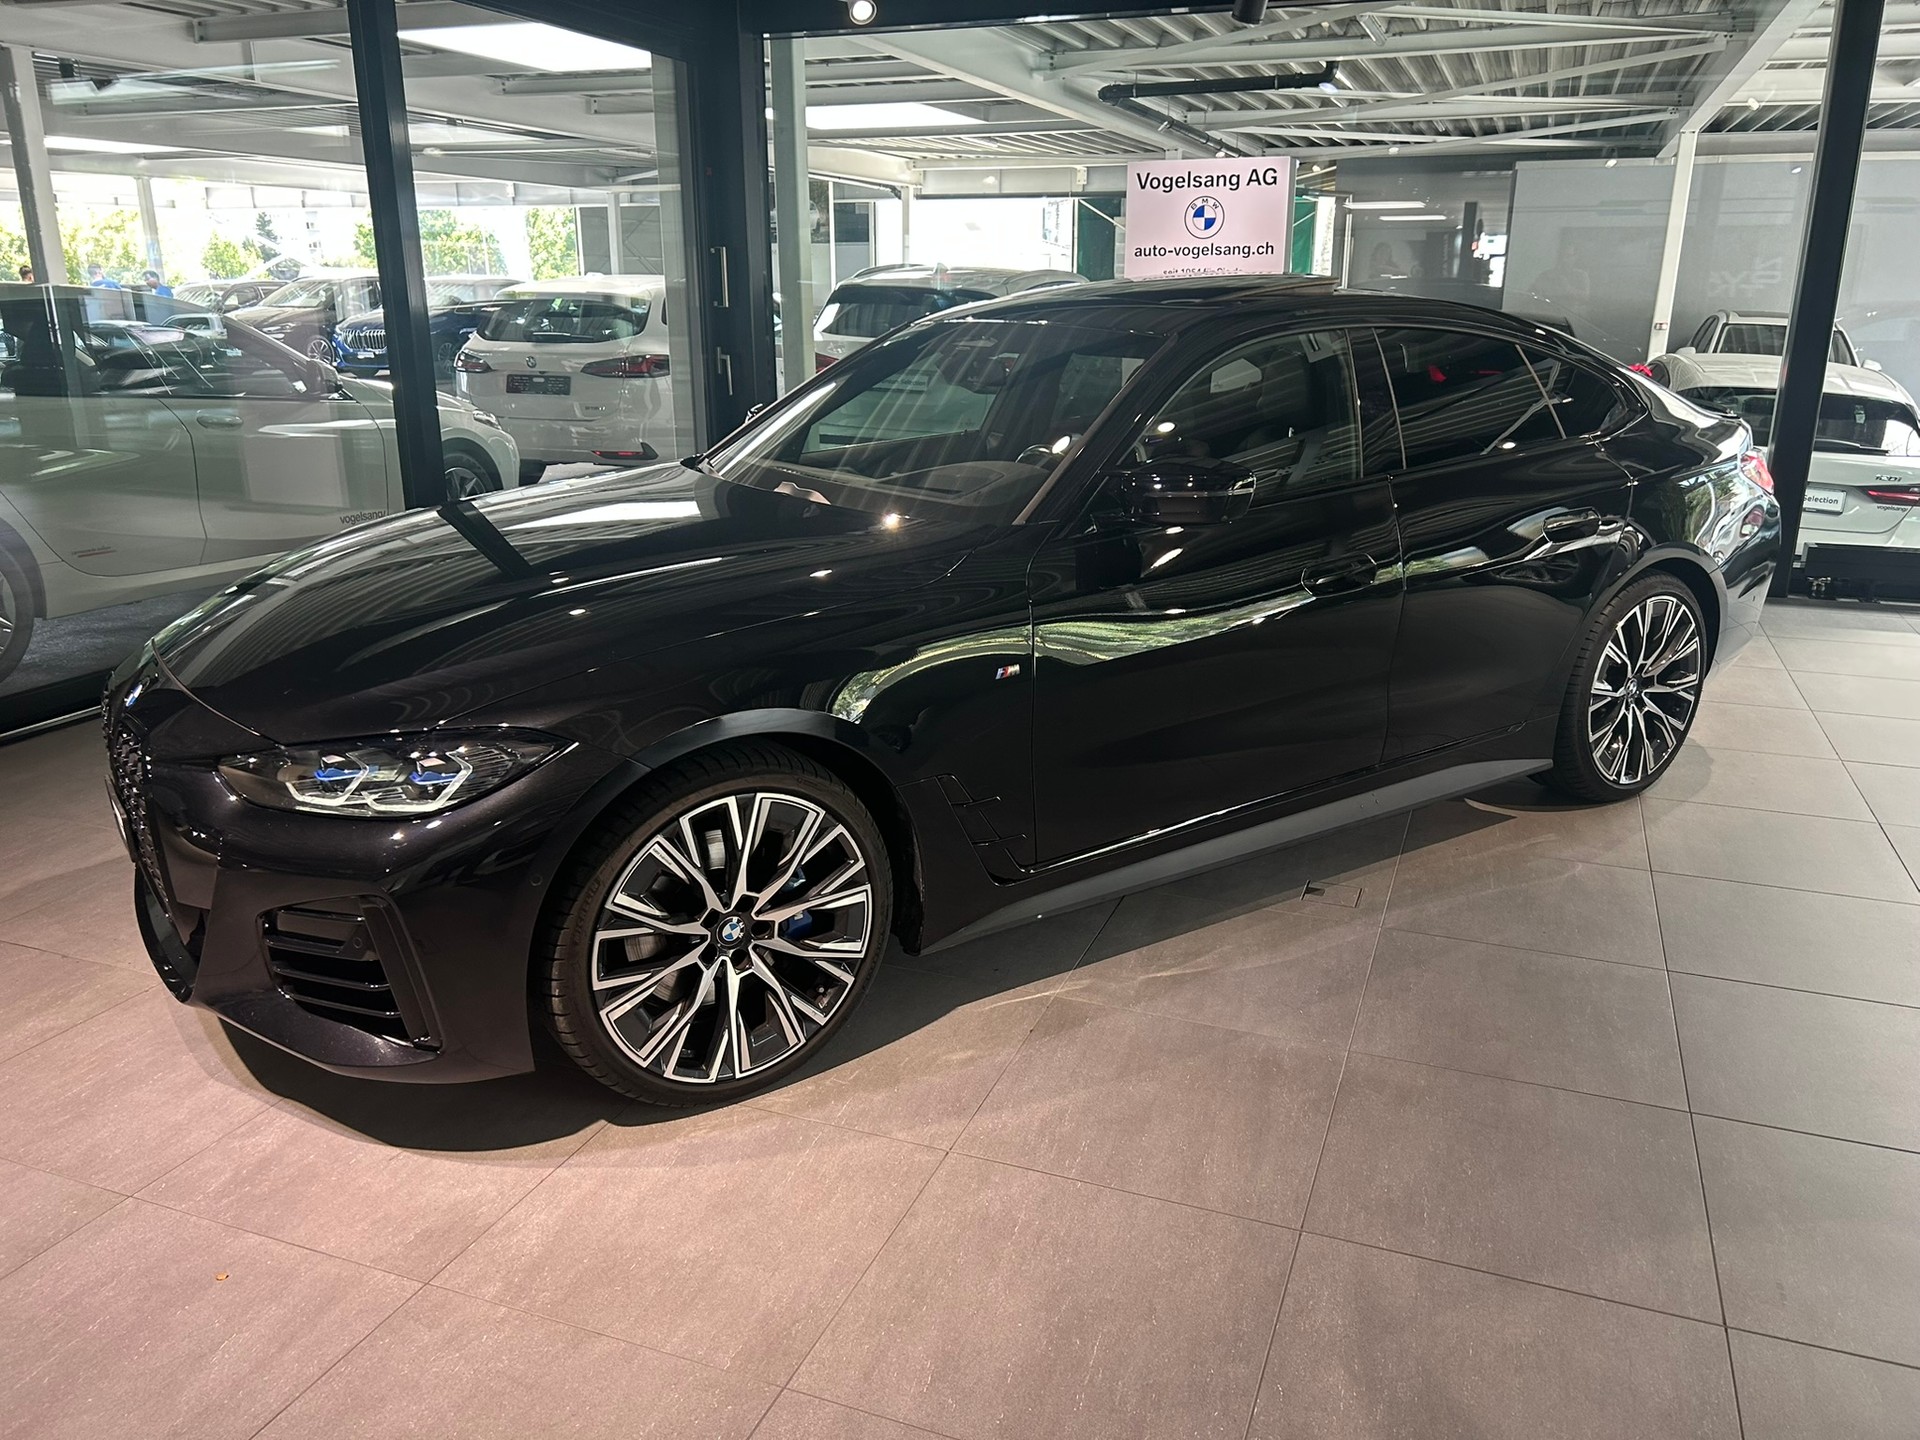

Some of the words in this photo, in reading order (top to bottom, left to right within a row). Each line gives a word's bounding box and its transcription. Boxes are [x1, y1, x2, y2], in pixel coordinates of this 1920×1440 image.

[1136, 171, 1241, 193] Vogelsang
[1246, 168, 1278, 187] AG
[1134, 241, 1274, 259] auto-vogelsang.ch
